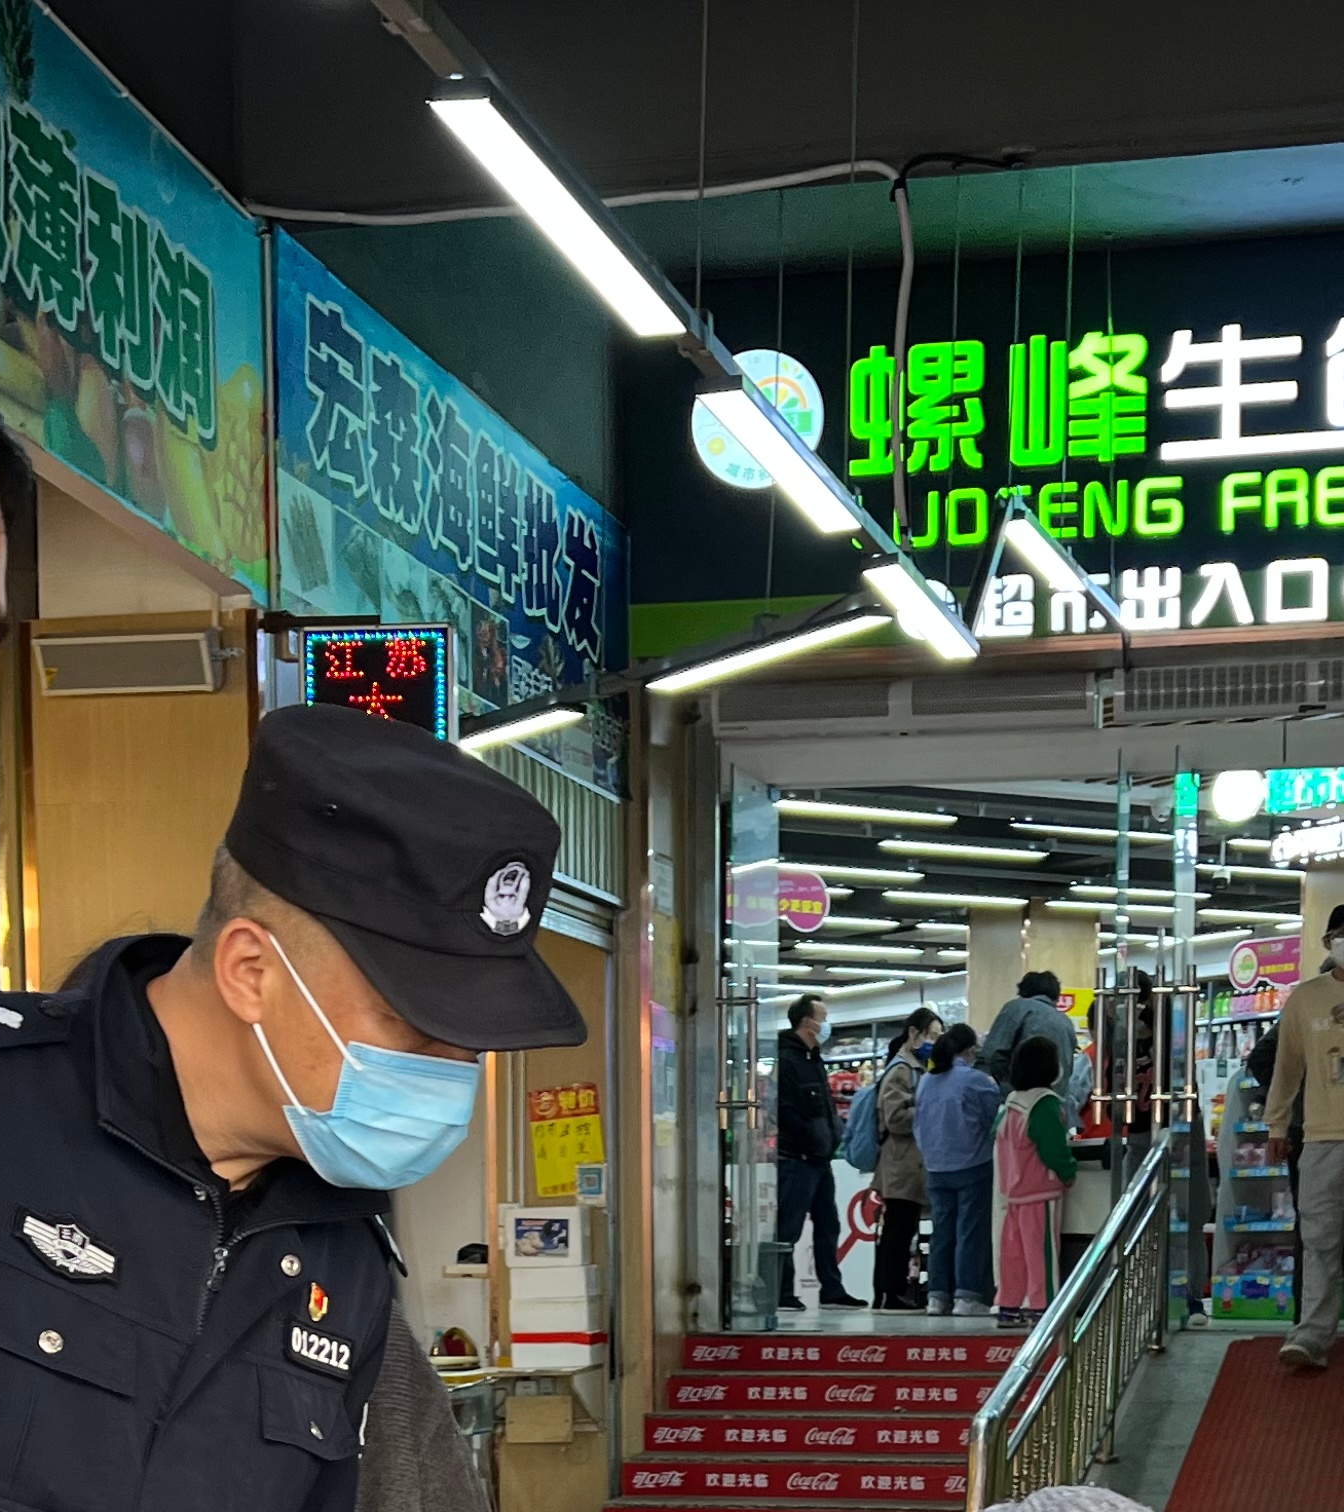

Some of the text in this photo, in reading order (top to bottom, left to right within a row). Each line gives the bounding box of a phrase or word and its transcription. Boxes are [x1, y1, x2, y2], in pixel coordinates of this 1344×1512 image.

[304, 292, 602, 664] 宏森海鲜批发
[852, 476, 1185, 549] UOENG
[291, 1326, 351, 1371] 012212
[761, 1347, 820, 1360] 欢迎光临
[907, 1347, 968, 1361] 欢迎光临
[748, 1386, 808, 1400] 欢迎光临
[896, 1387, 958, 1401] 欢迎光临
[725, 1428, 787, 1443] 欢迎光临
[877, 1430, 940, 1444] 欢迎光临
[706, 1473, 769, 1488] 欢迎光临
[861, 1475, 926, 1490] 欢迎光临
